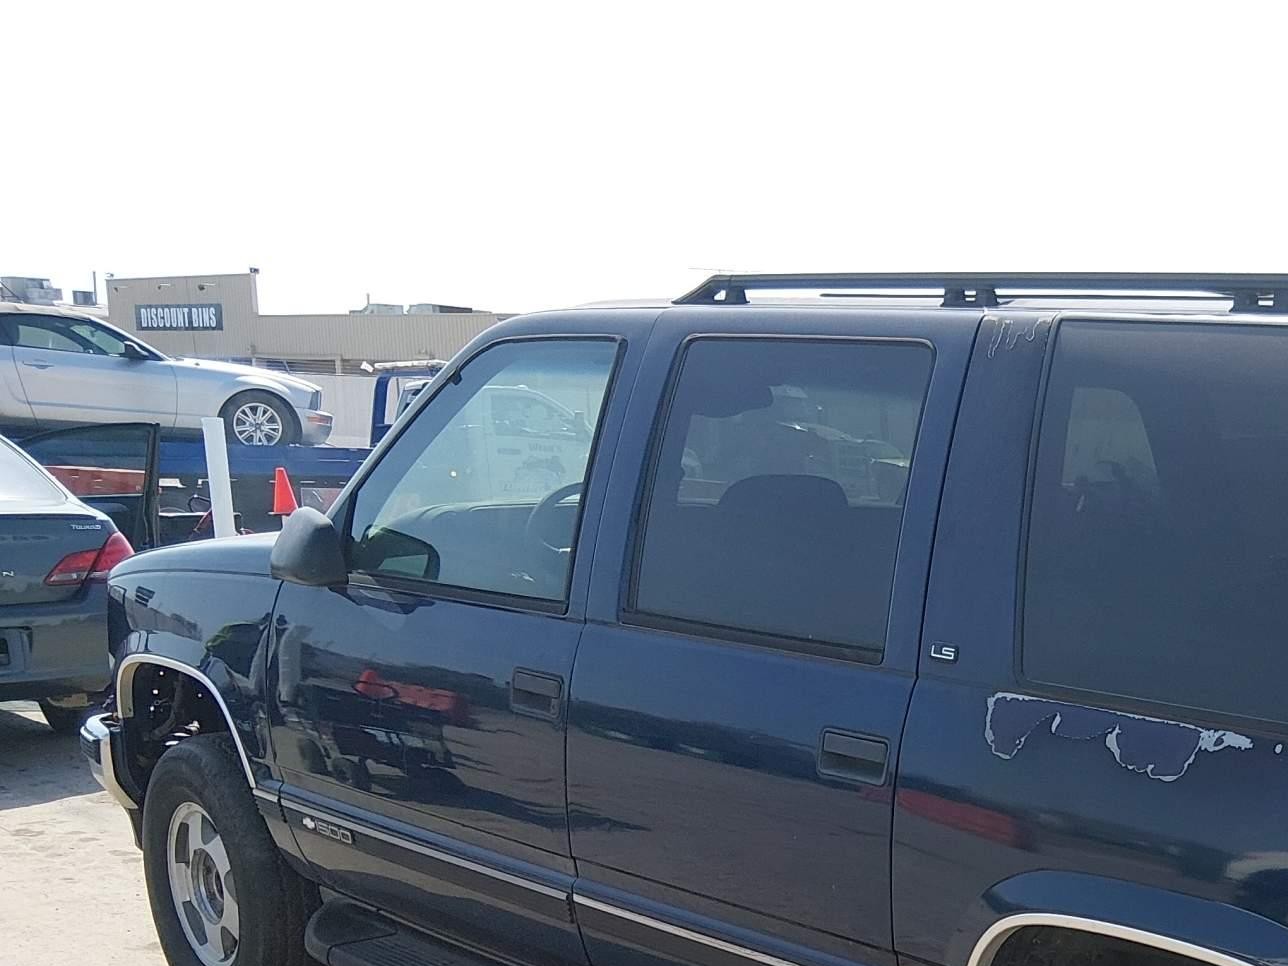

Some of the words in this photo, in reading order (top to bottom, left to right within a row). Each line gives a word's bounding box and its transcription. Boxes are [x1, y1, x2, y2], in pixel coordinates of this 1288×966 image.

[140, 307, 189, 328] DISCOUNT
[191, 307, 217, 328] BINS
[930, 644, 956, 660] LS
[315, 819, 352, 844] 1500
